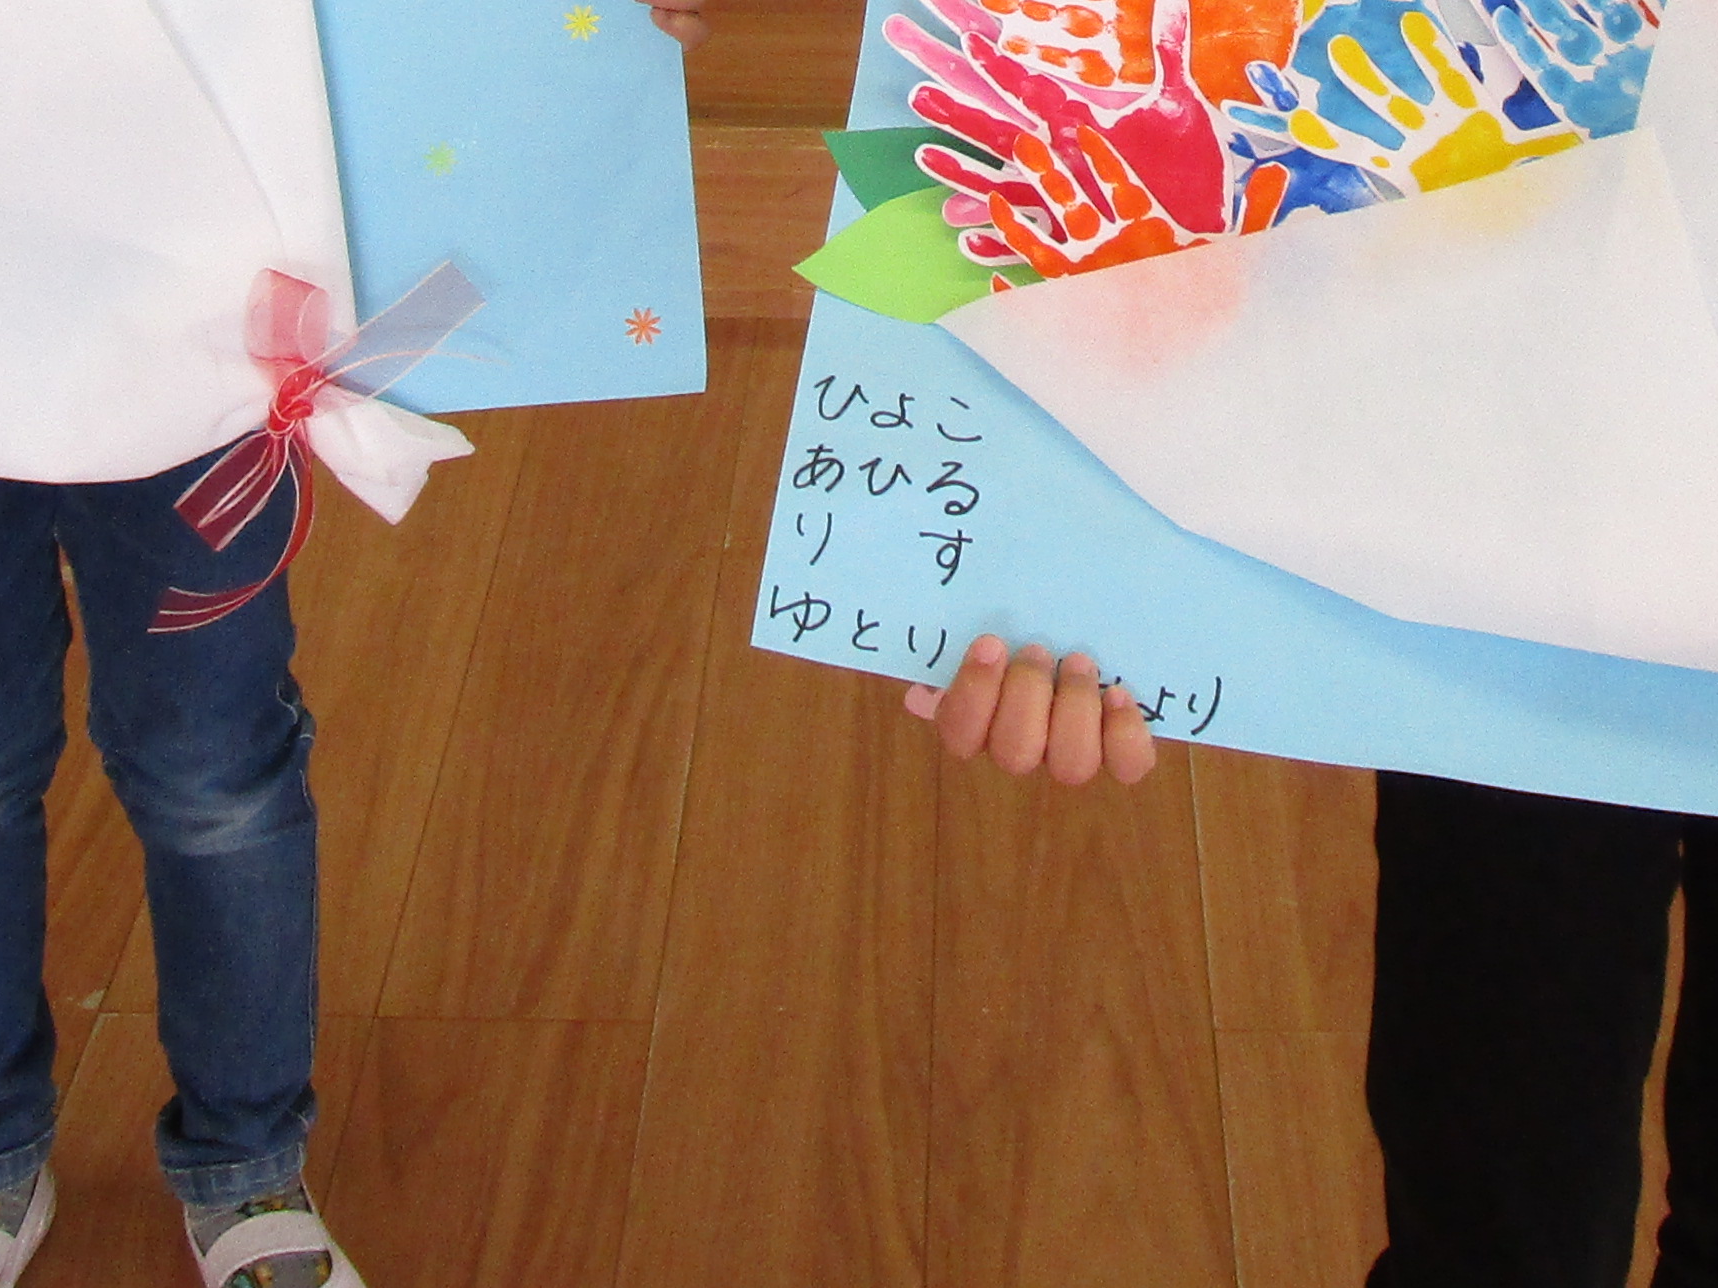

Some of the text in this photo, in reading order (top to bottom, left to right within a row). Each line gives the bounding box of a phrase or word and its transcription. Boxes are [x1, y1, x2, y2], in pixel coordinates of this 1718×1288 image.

[814, 375, 983, 442] ひよこ
[792, 444, 981, 516] あひる
